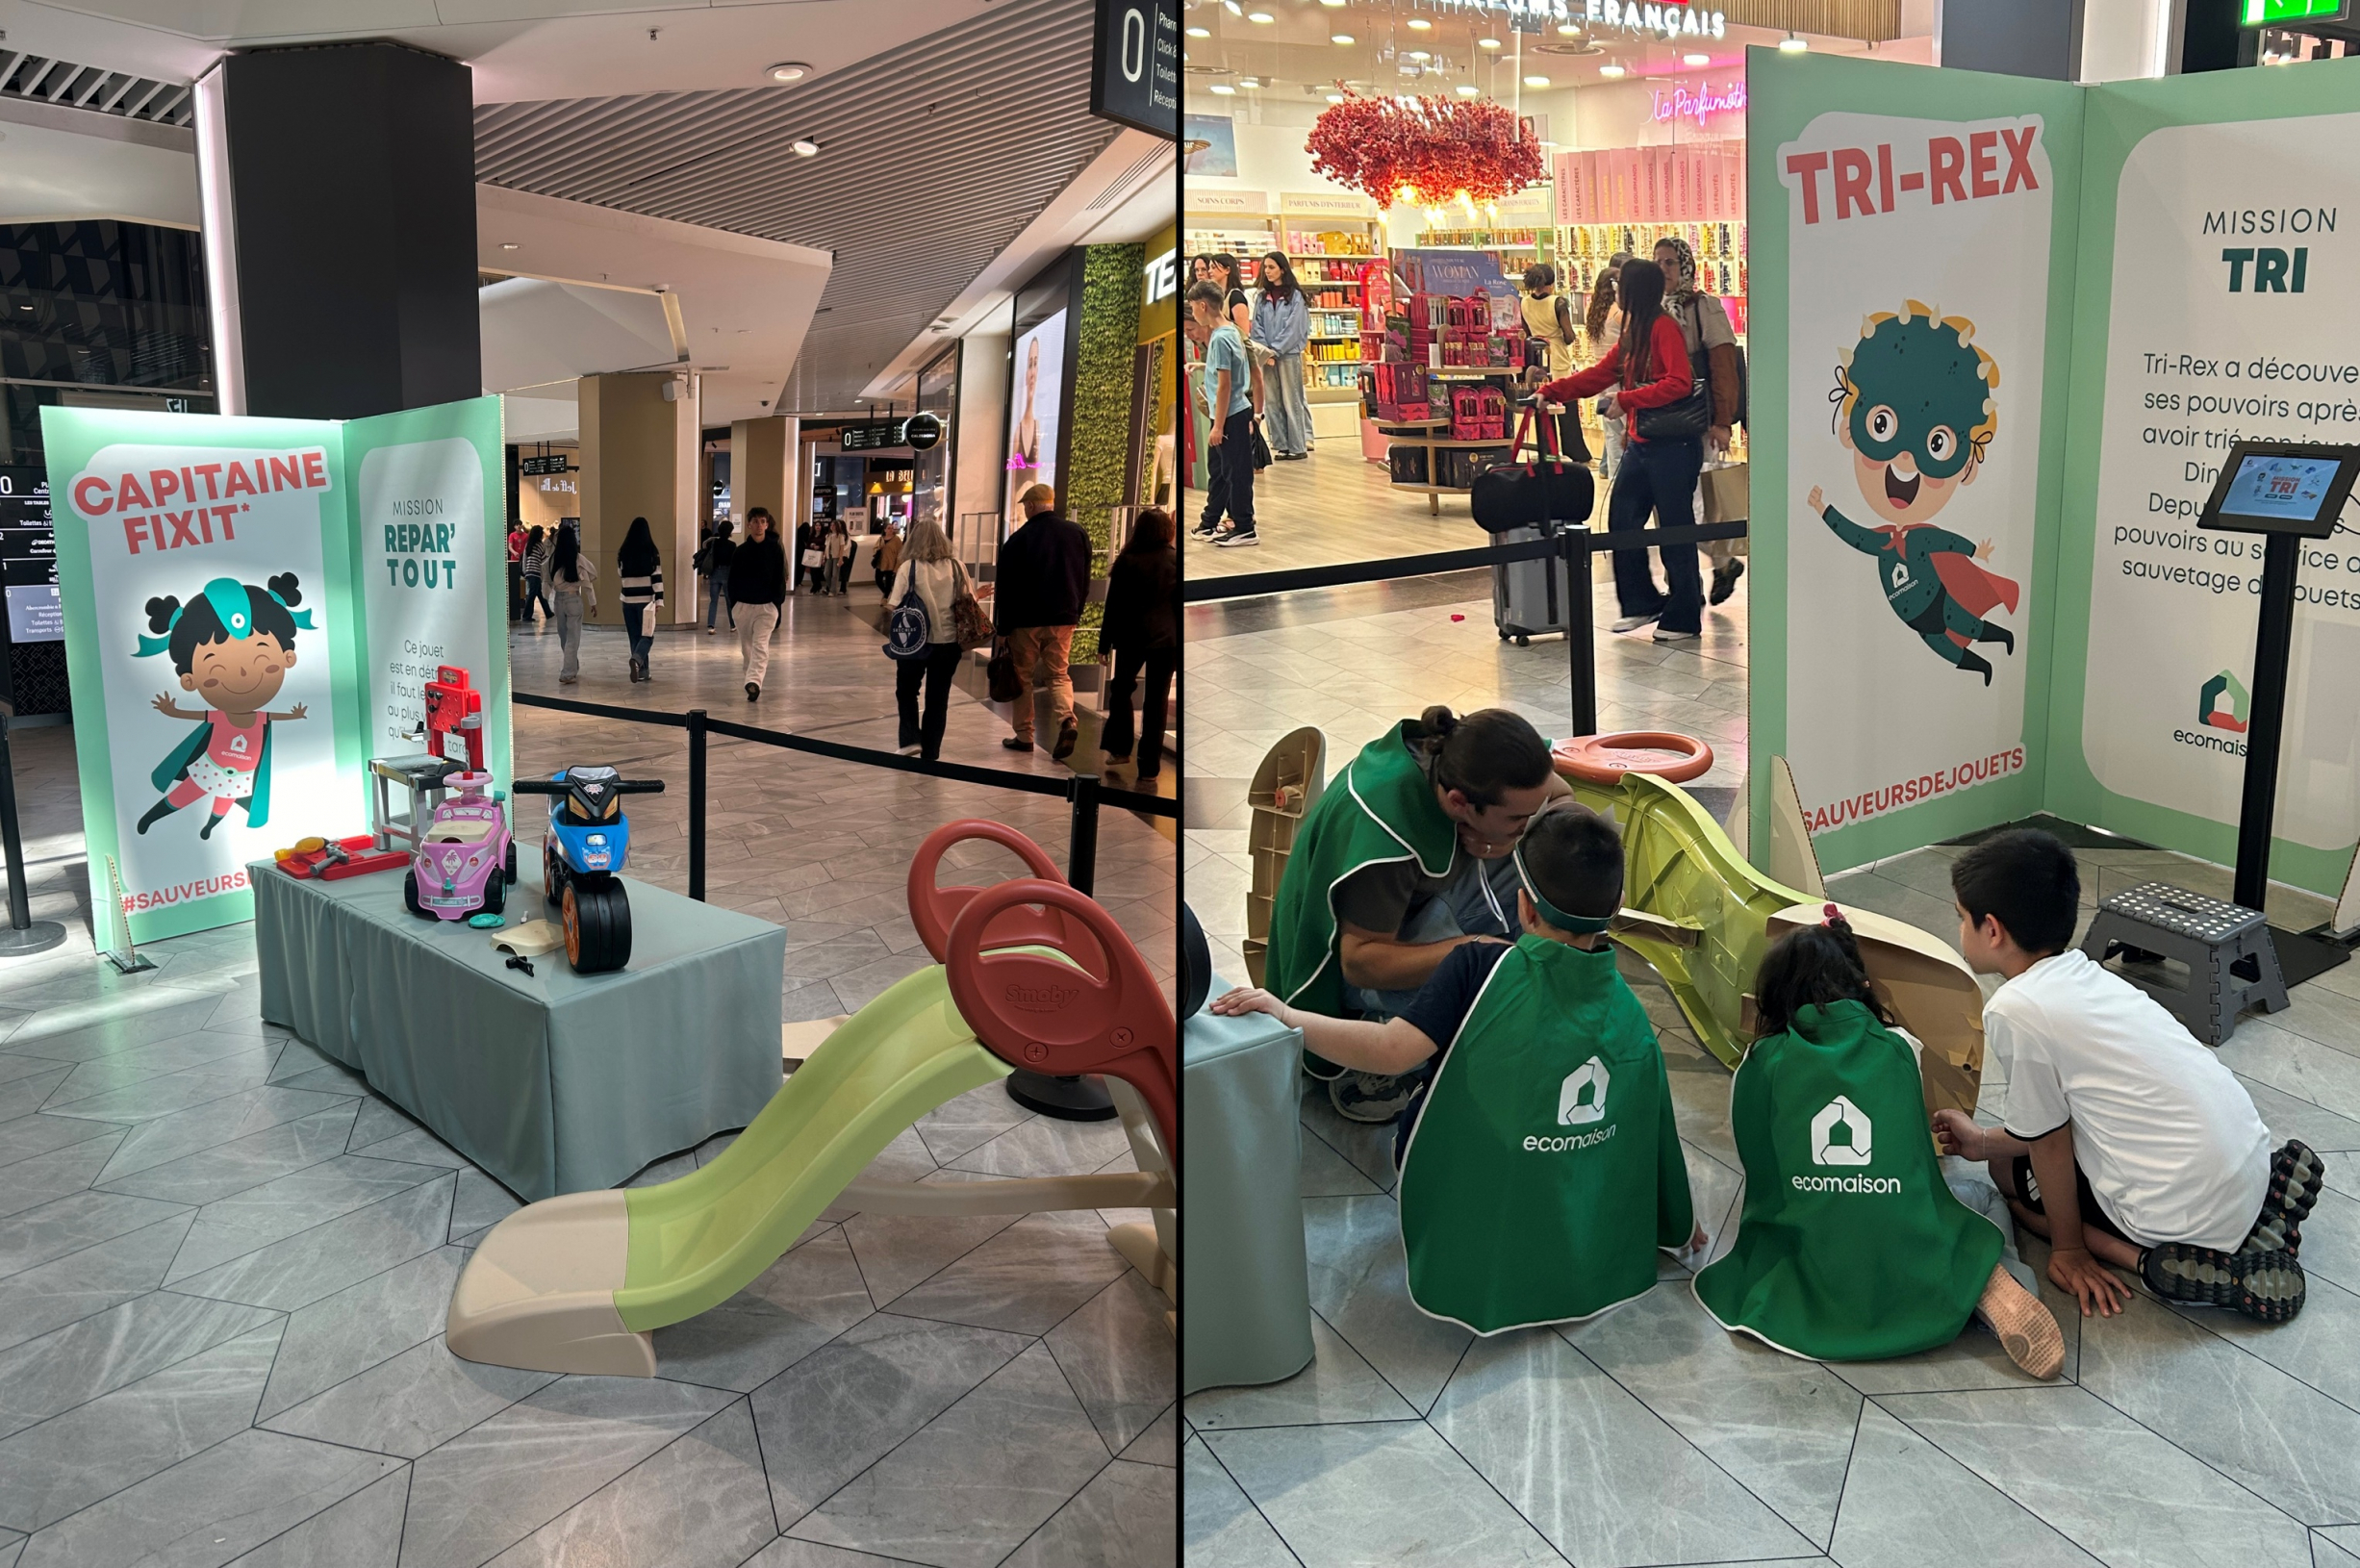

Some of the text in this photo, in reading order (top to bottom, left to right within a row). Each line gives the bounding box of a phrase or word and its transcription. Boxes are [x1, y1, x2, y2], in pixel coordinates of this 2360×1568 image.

[1586, 0, 1725, 38] FRANÇAIS
[1122, 8, 1145, 83] 0
[1157, 38, 1172, 55] Click
[1654, 89, 1673, 120] La
[1787, 126, 2040, 225] TRI-REX
[2203, 207, 2338, 235] MISSION
[1432, 265, 1480, 279] WOMAN
[2221, 247, 2308, 293] TRI
[2144, 353, 2360, 383] Tri-Rex a découve
[2144, 392, 2180, 410] ses
[2187, 394, 2289, 417] pouvoirs
[845, 432, 851, 446] 0
[2143, 426, 2242, 449] avoir trié
[1, 475, 13, 494] 0
[74, 452, 327, 516] CAPITAINE
[2184, 462, 2220, 483] Din
[2270, 481, 2299, 494] TRI
[393, 498, 444, 516] MISSION
[385, 523, 455, 553] REPAR'
[2114, 525, 2208, 552] pouvoirs
[2214, 539, 2244, 557] au
[2250, 544, 2339, 569] sice
[387, 558, 456, 589] TOUT
[2122, 559, 2241, 594] sauvetage
[2294, 585, 2360, 610] ouets
[1889, 579, 1918, 600] ecomaison
[404, 640, 444, 658] Ce jouet
[390, 662, 403, 673] est
[406, 666, 417, 676] en
[390, 681, 395, 695] il
[397, 682, 417, 698] faut
[388, 705, 399, 717] au
[401, 706, 419, 721] plus
[221, 750, 252, 761] ecomaison
[1005, 983, 1078, 1010] Smoby
[1523, 1124, 1616, 1152] ecomaison
[1791, 1174, 1901, 1194] ecomaison
